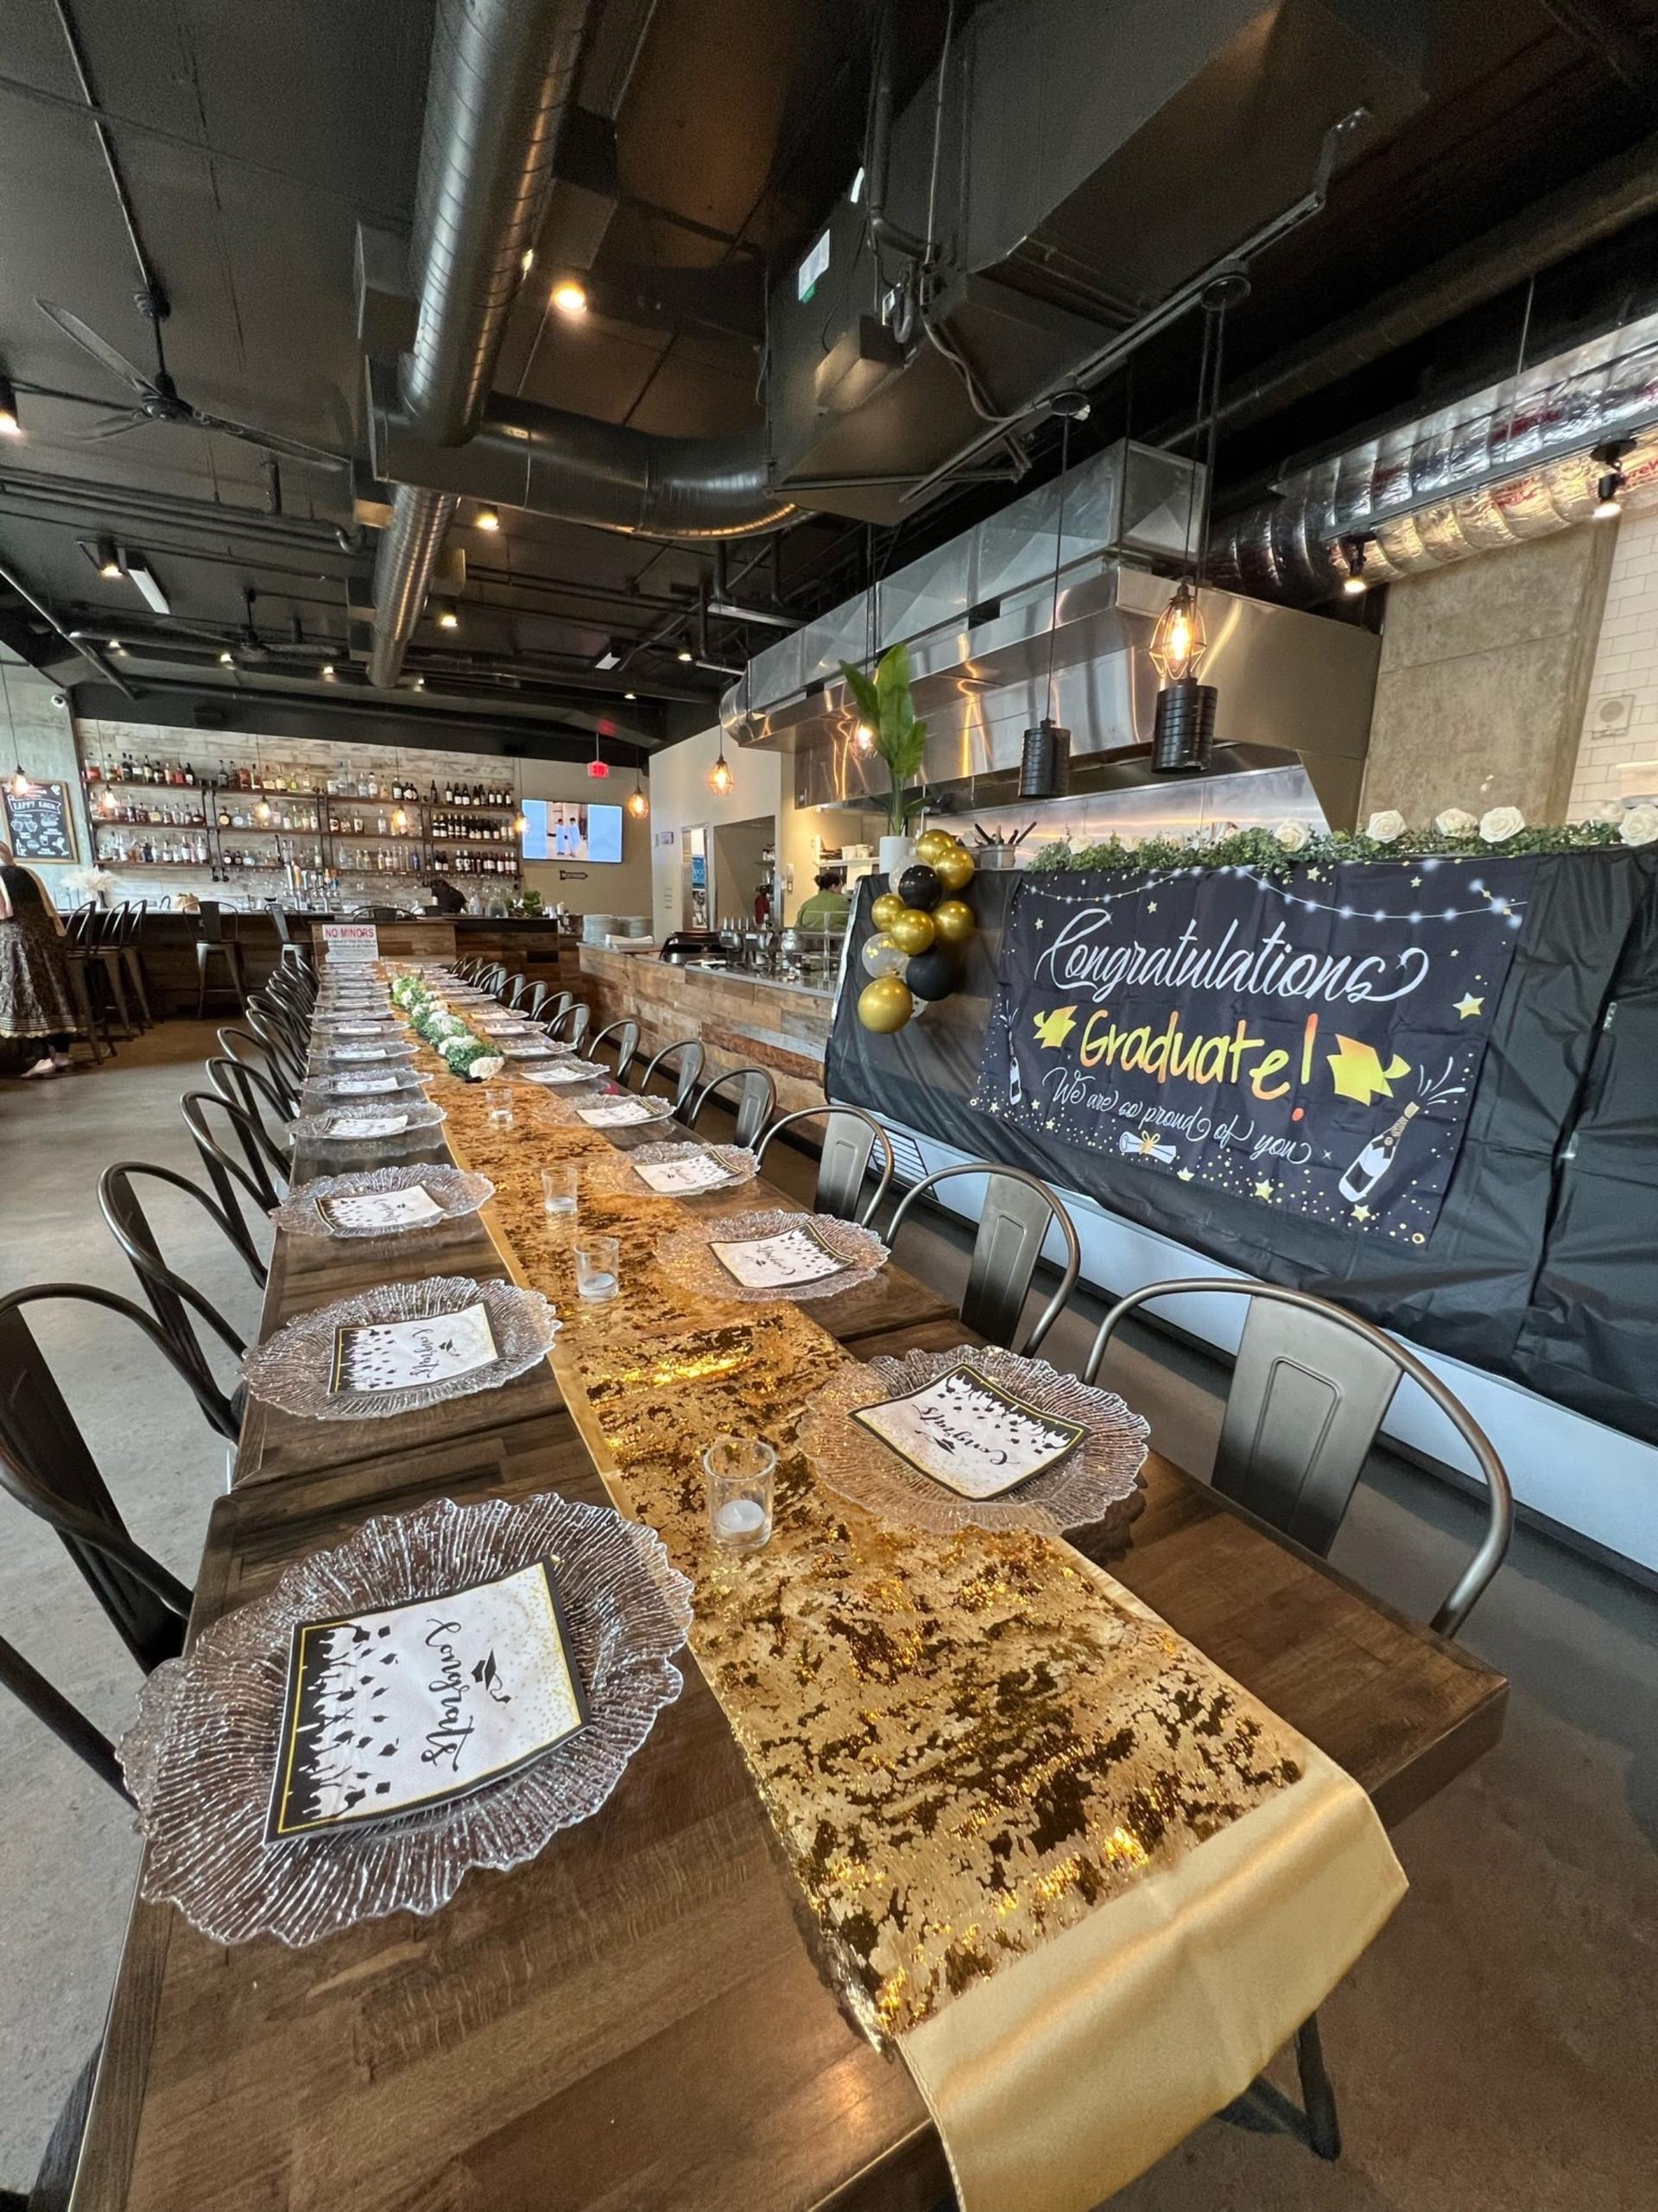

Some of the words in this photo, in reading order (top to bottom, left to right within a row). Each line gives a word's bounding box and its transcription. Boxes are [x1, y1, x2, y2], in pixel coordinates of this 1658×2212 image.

[325, 927, 339, 938] NO
[340, 927, 375, 938] MINORS
[1035, 908, 1430, 1003] Congratulations
[1079, 1009, 1319, 1122] Graduate!
[1042, 1066, 1097, 1105] We
[1085, 1090, 1119, 1112] are
[1118, 1101, 1143, 1117] so
[1138, 1106, 1212, 1142] proud
[1213, 1114, 1255, 1149] of
[1250, 1133, 1313, 1165] you
[911, 1403, 1022, 1466] Congrats
[421, 1618, 476, 1773] Congrats
